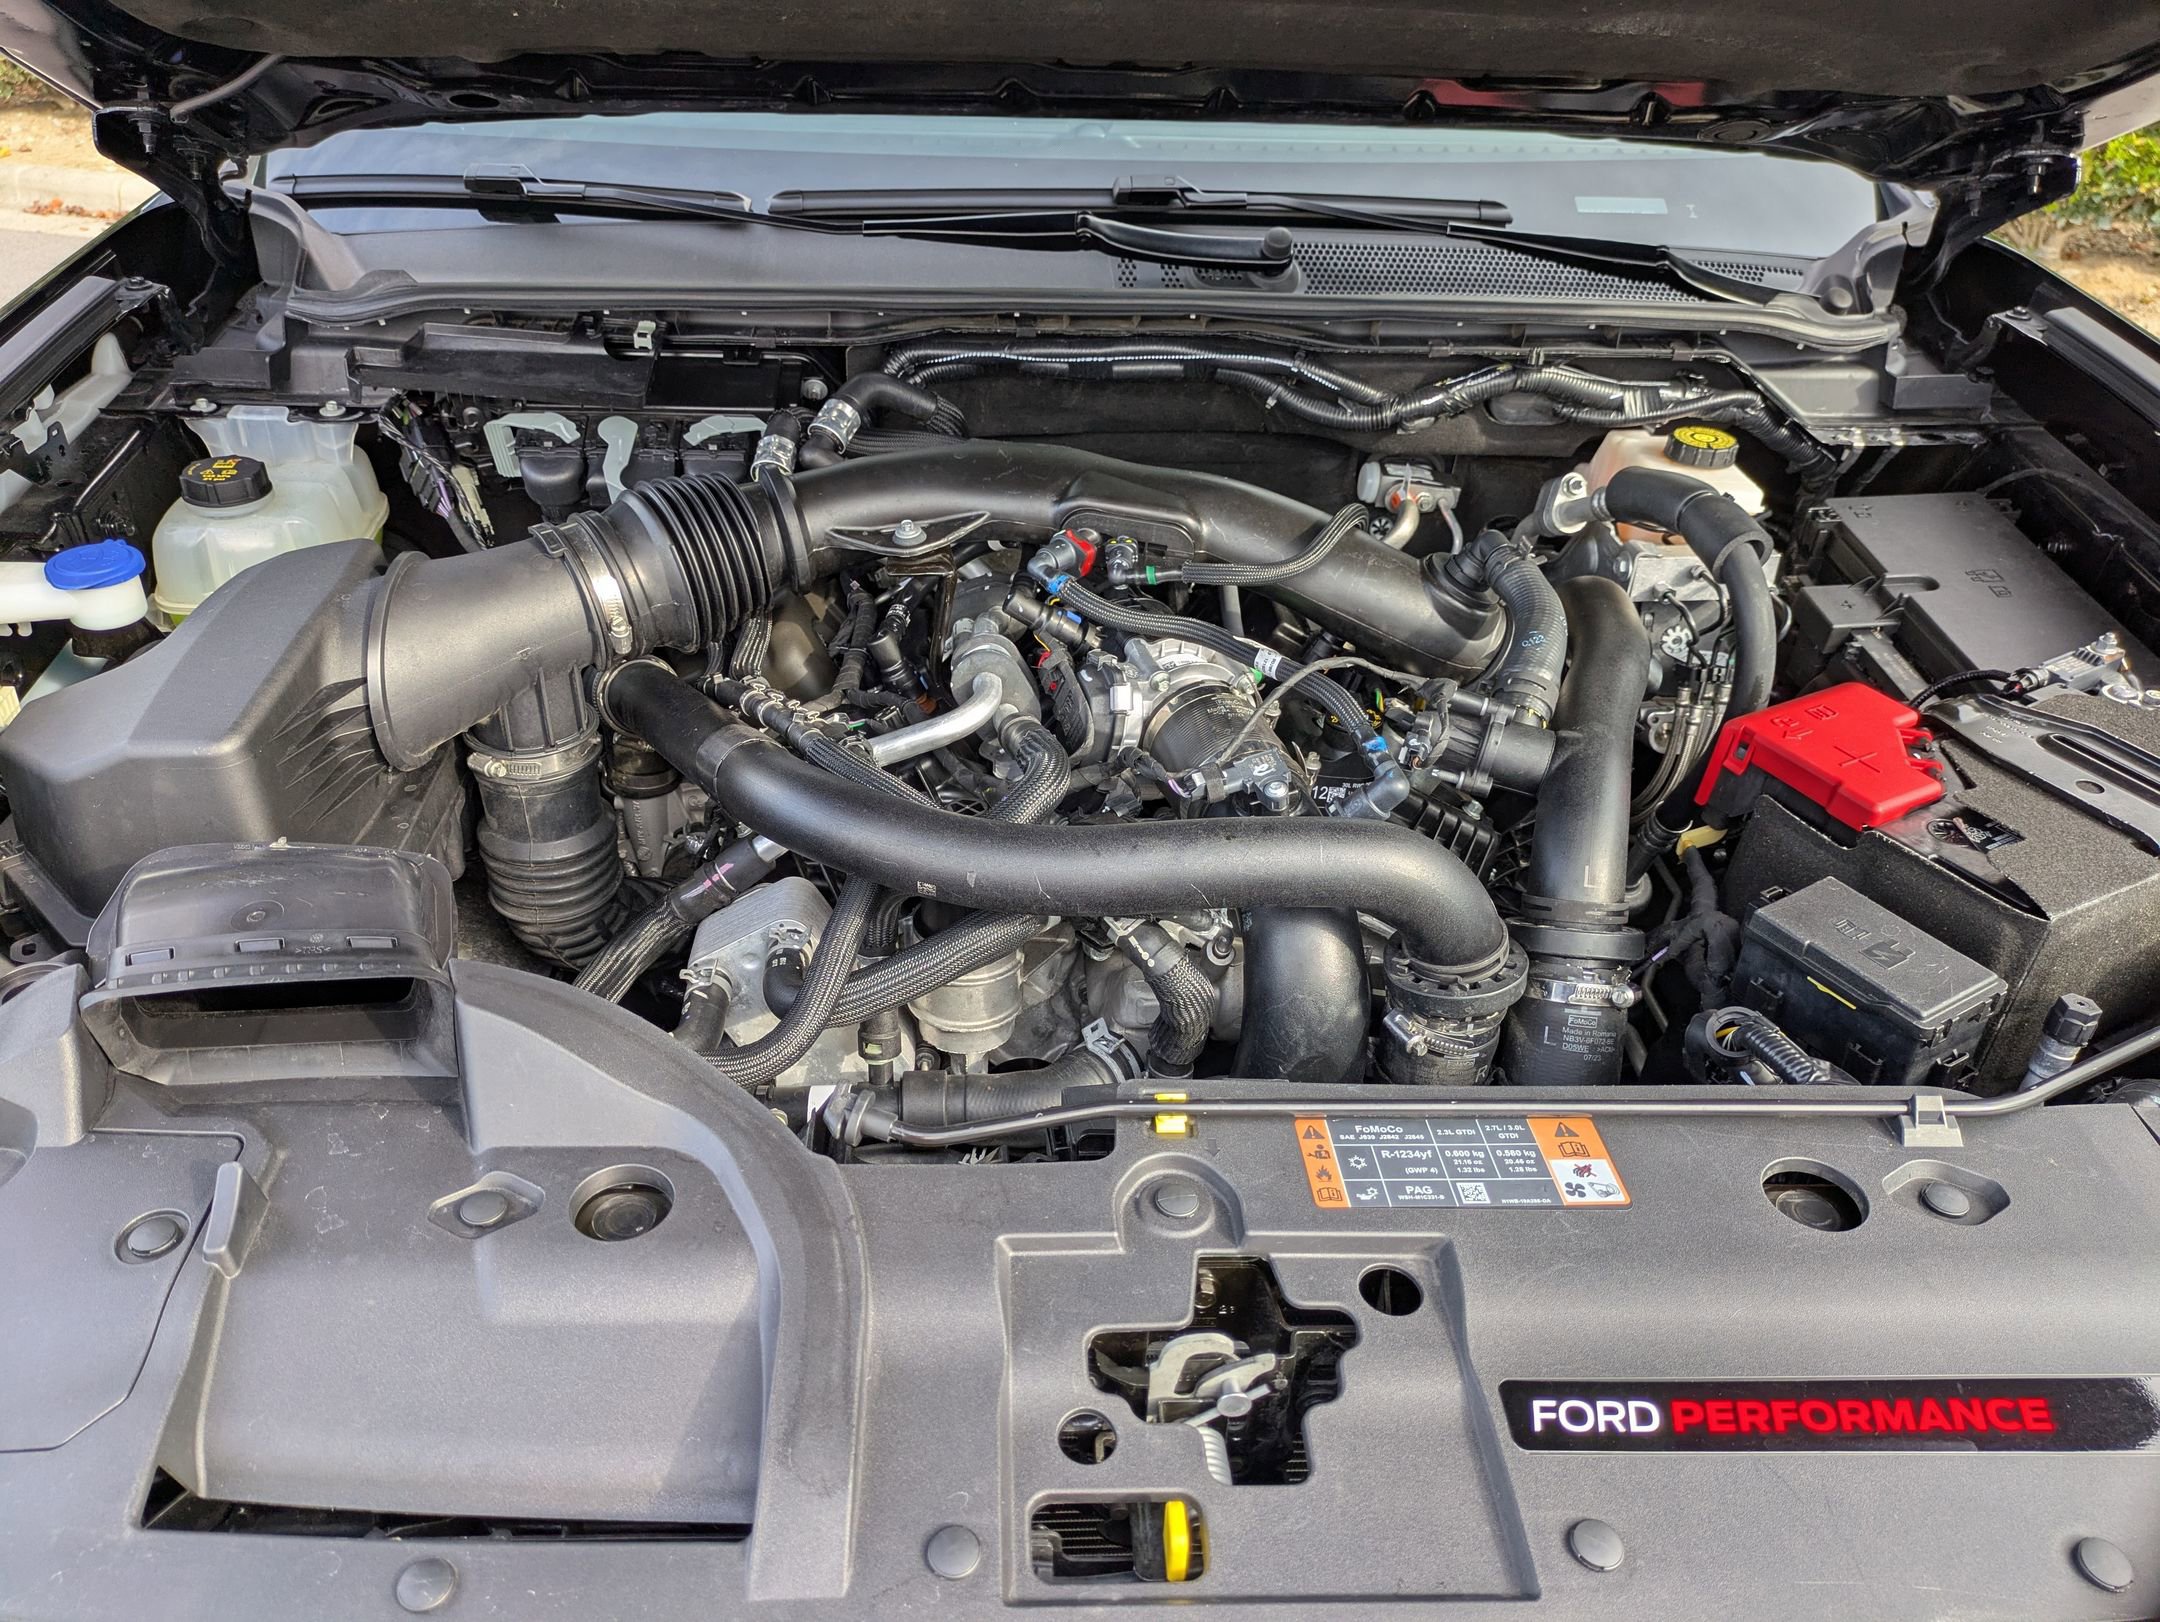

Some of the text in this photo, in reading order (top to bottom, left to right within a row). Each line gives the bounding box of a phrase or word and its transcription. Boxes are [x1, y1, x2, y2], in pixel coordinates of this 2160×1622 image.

[1562, 1027, 1583, 1036] Made
[1354, 1125, 1404, 1133] FoMoCo
[1381, 1149, 1433, 1160] R-1234yf
[1471, 1150, 1485, 1158] kg
[1523, 1149, 1536, 1157] kg
[1405, 1185, 1433, 1195] PAG
[1532, 1398, 2055, 1434] FORD PERFORMANCE
